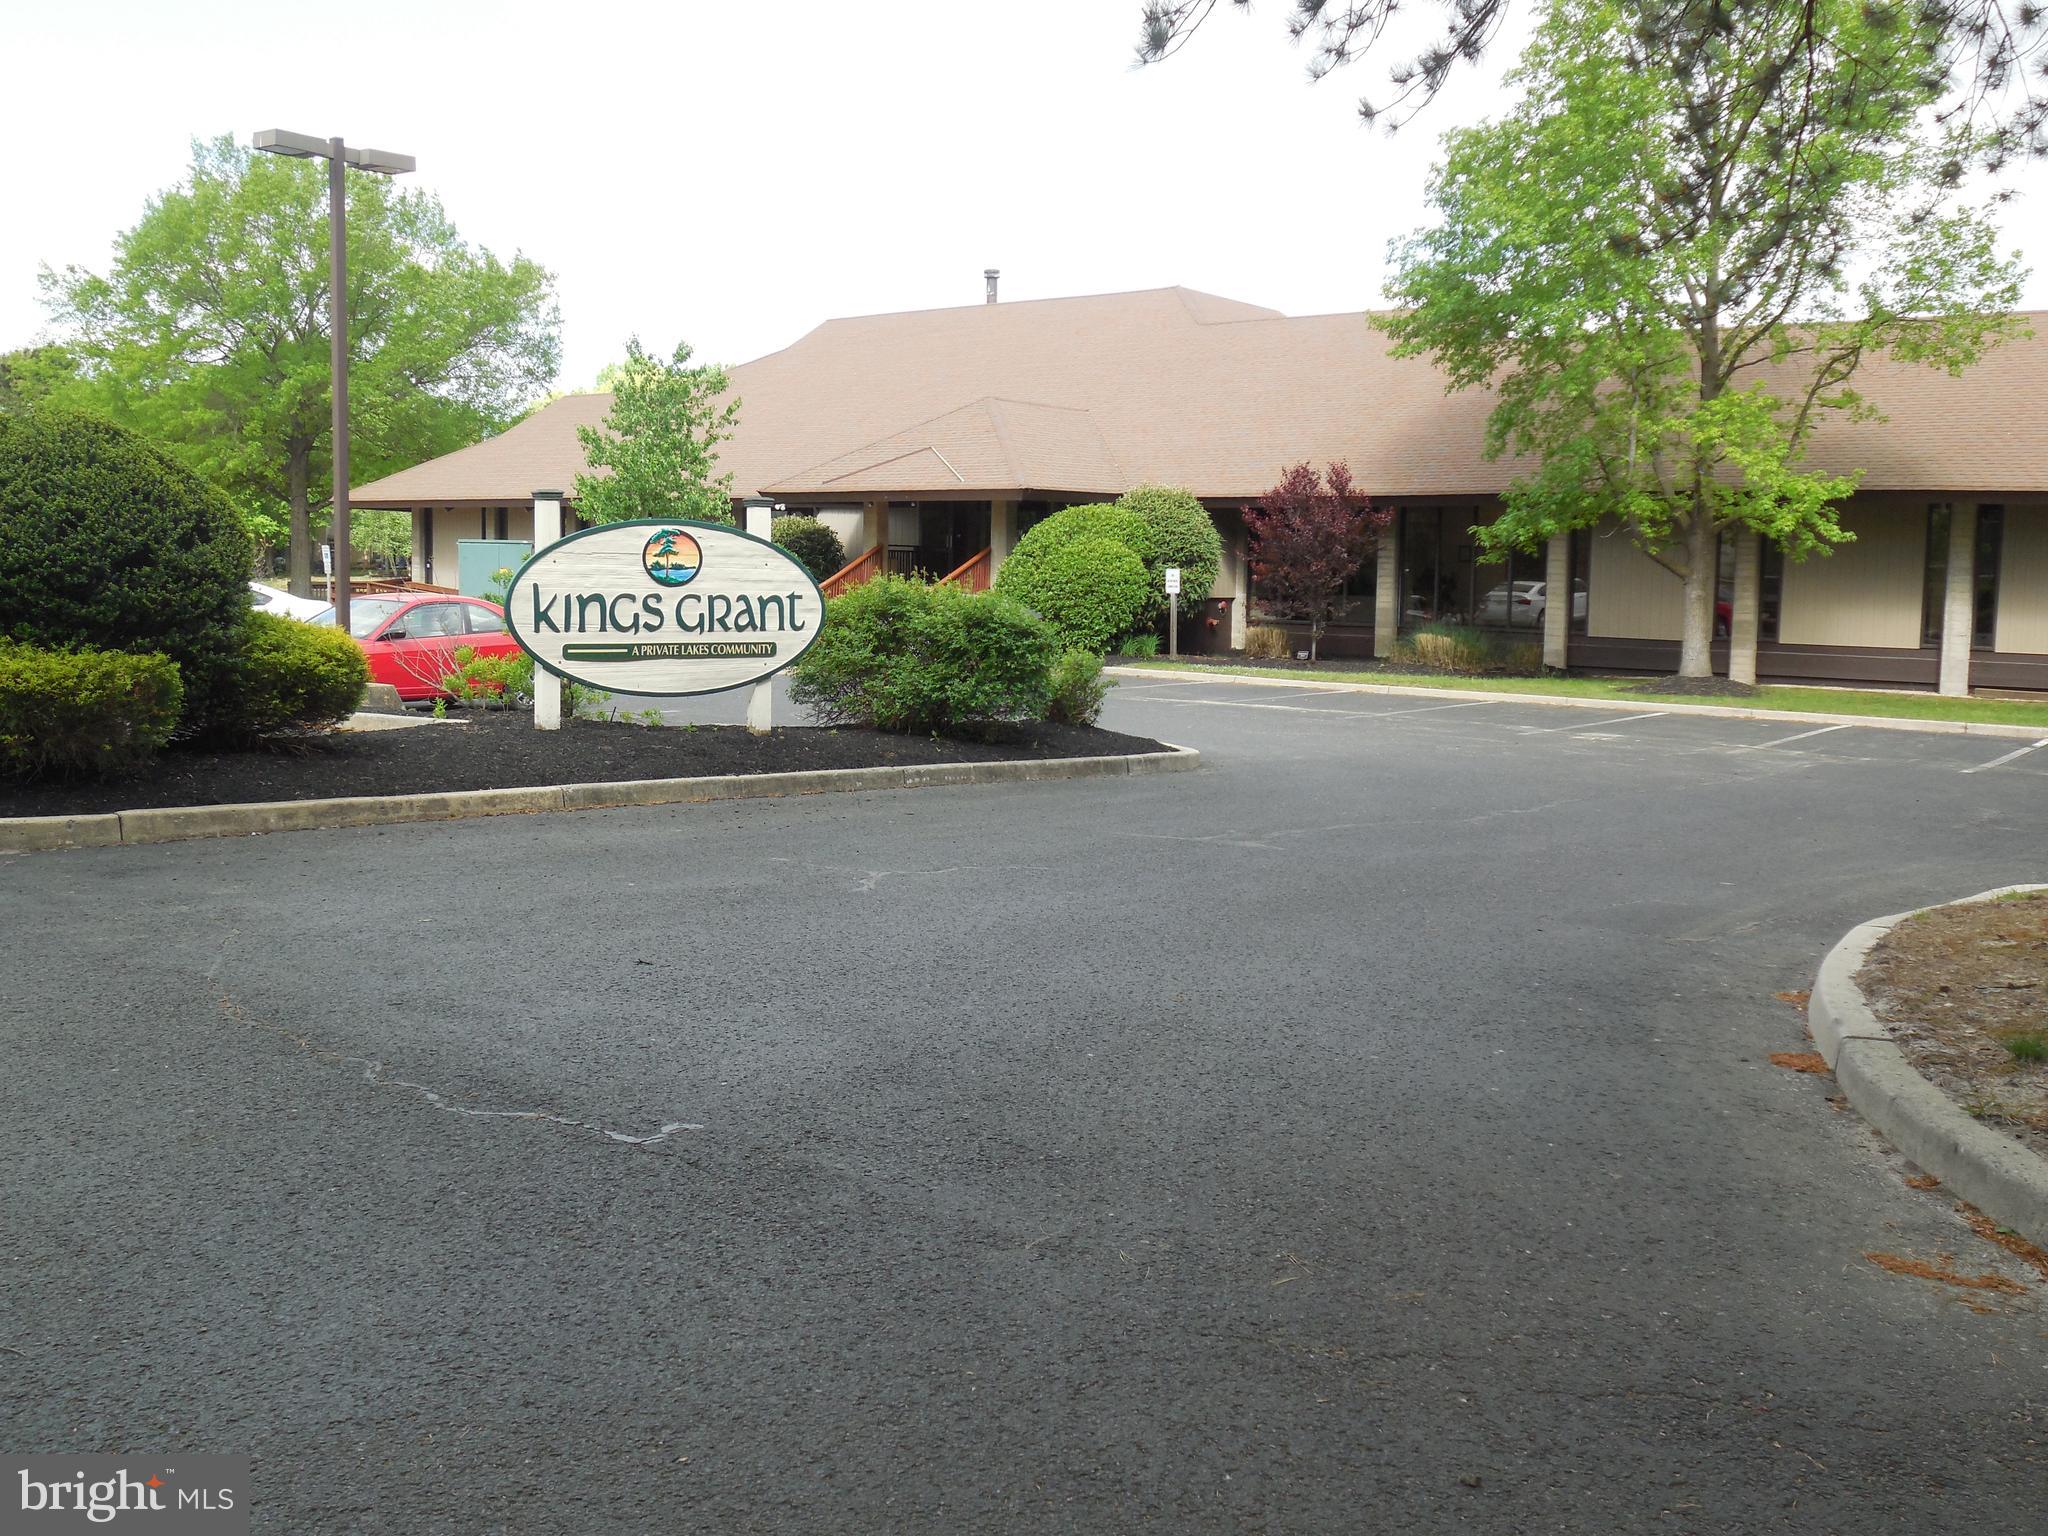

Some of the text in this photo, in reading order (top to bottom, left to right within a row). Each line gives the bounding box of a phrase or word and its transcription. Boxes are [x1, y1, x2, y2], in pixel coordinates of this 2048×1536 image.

[631, 643, 773, 656] A PRIVATE LAKES COMMUNITY
